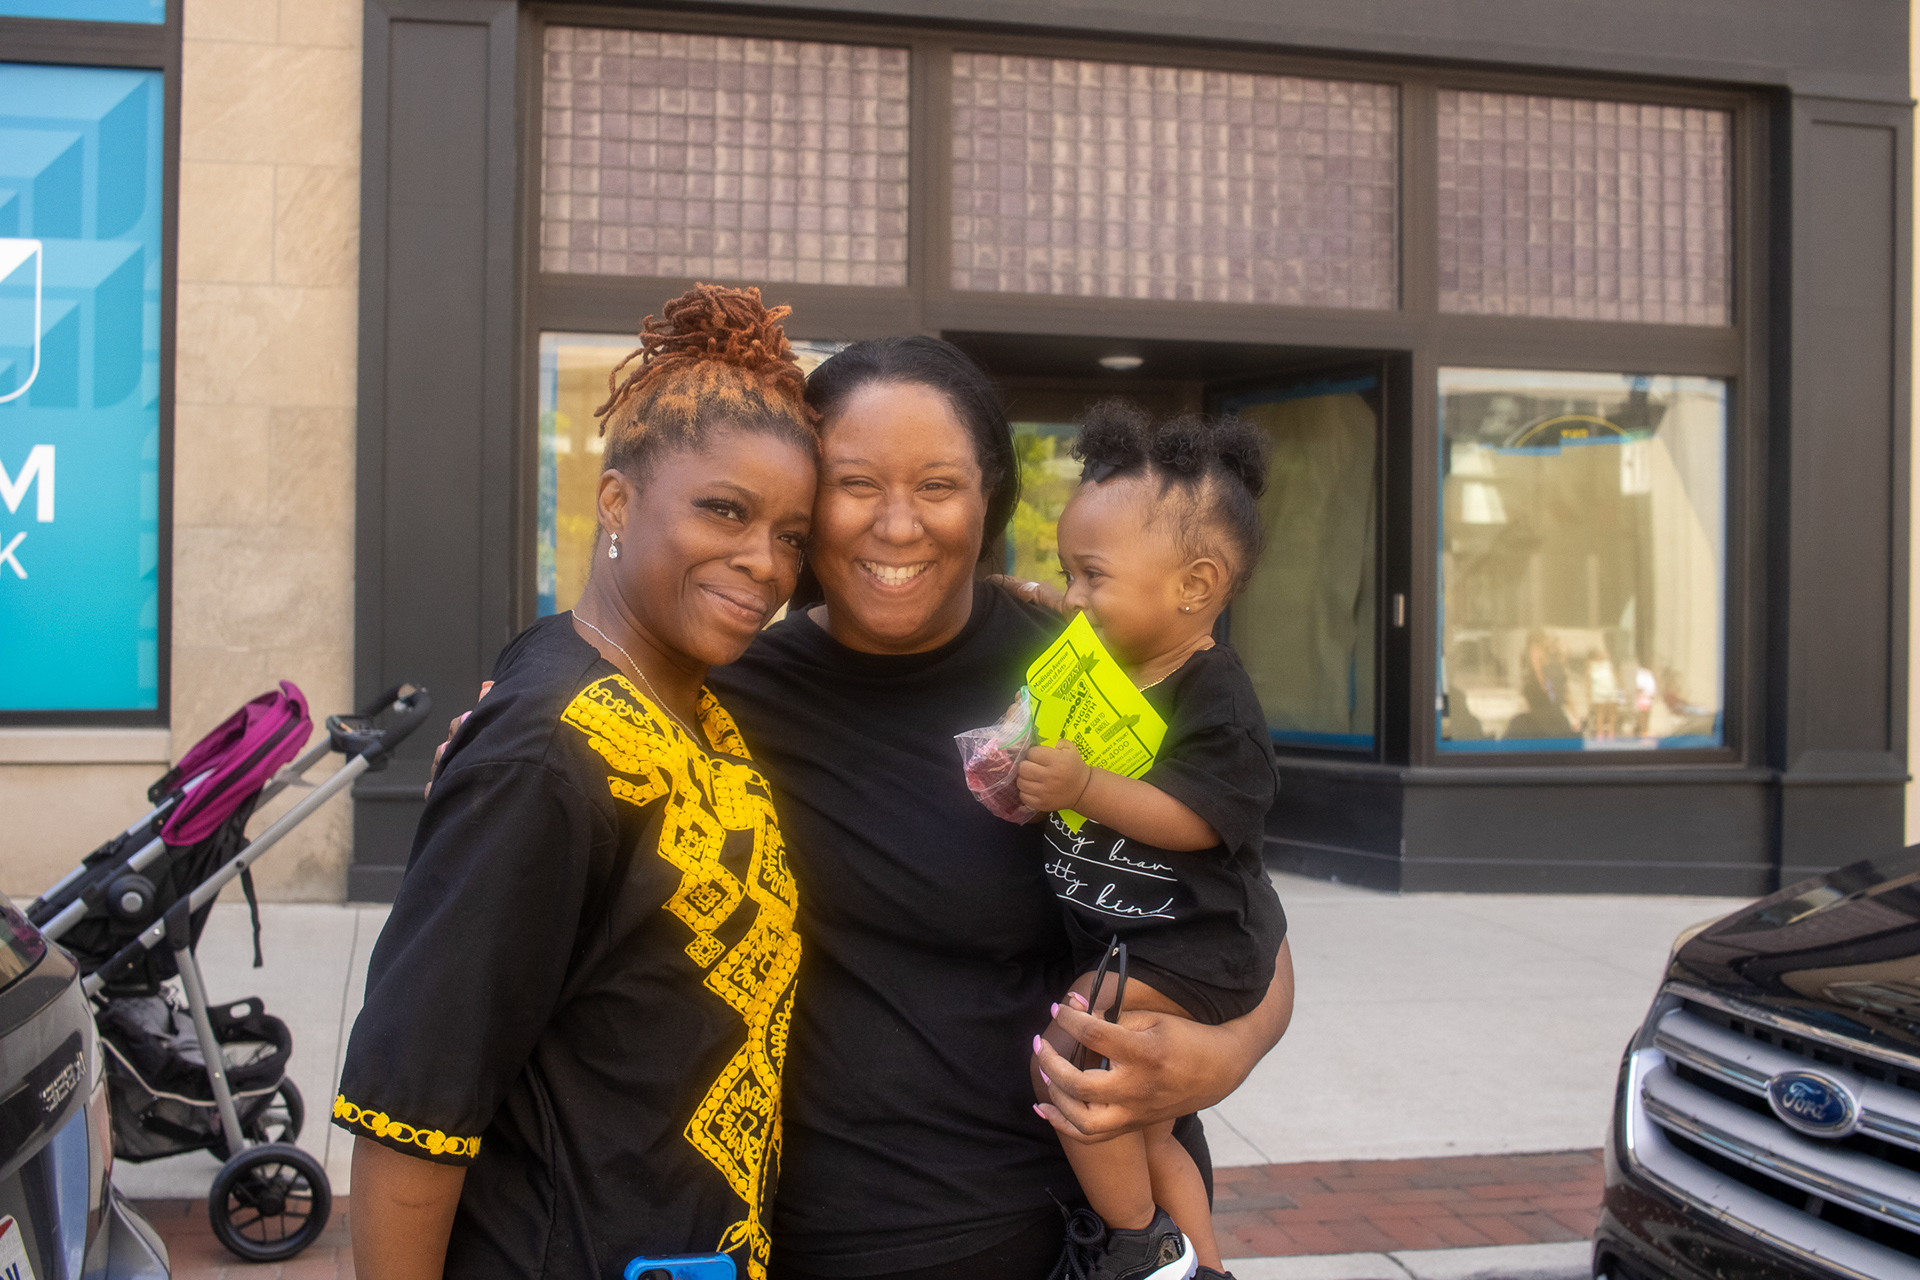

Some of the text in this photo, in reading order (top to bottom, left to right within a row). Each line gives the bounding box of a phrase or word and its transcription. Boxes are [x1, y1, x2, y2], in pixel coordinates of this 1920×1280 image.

[1073, 694, 1094, 729] AUGUST
[1082, 702, 1098, 724] 19TH
[1095, 719, 1110, 735] ENROLL
[1097, 740, 1130, 769] 59-4000
[1044, 858, 1089, 896] etty
[1782, 1081, 1831, 1120] Ford
